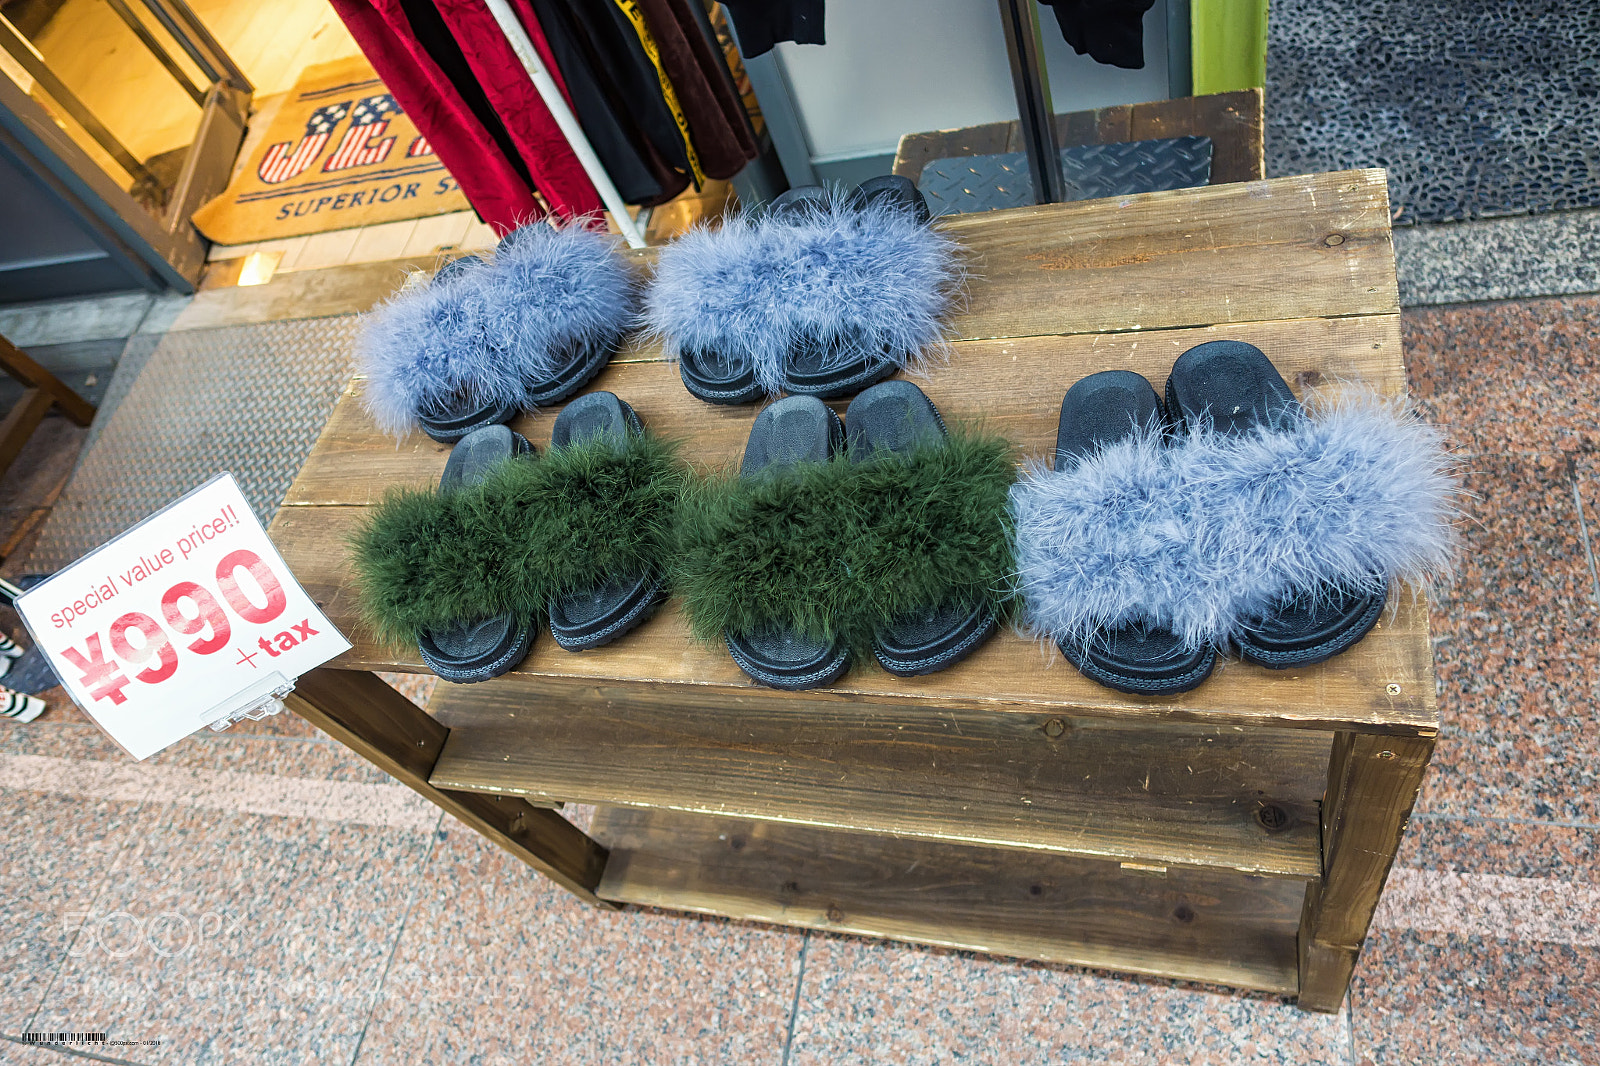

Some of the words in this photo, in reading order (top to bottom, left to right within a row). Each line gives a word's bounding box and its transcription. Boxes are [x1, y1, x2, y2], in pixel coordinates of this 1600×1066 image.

[278, 184, 420, 220] SUPERIOR
[51, 577, 119, 628] special
[120, 548, 174, 587] value
[177, 505, 240, 560] price!!
[60, 549, 287, 706] ¥990
